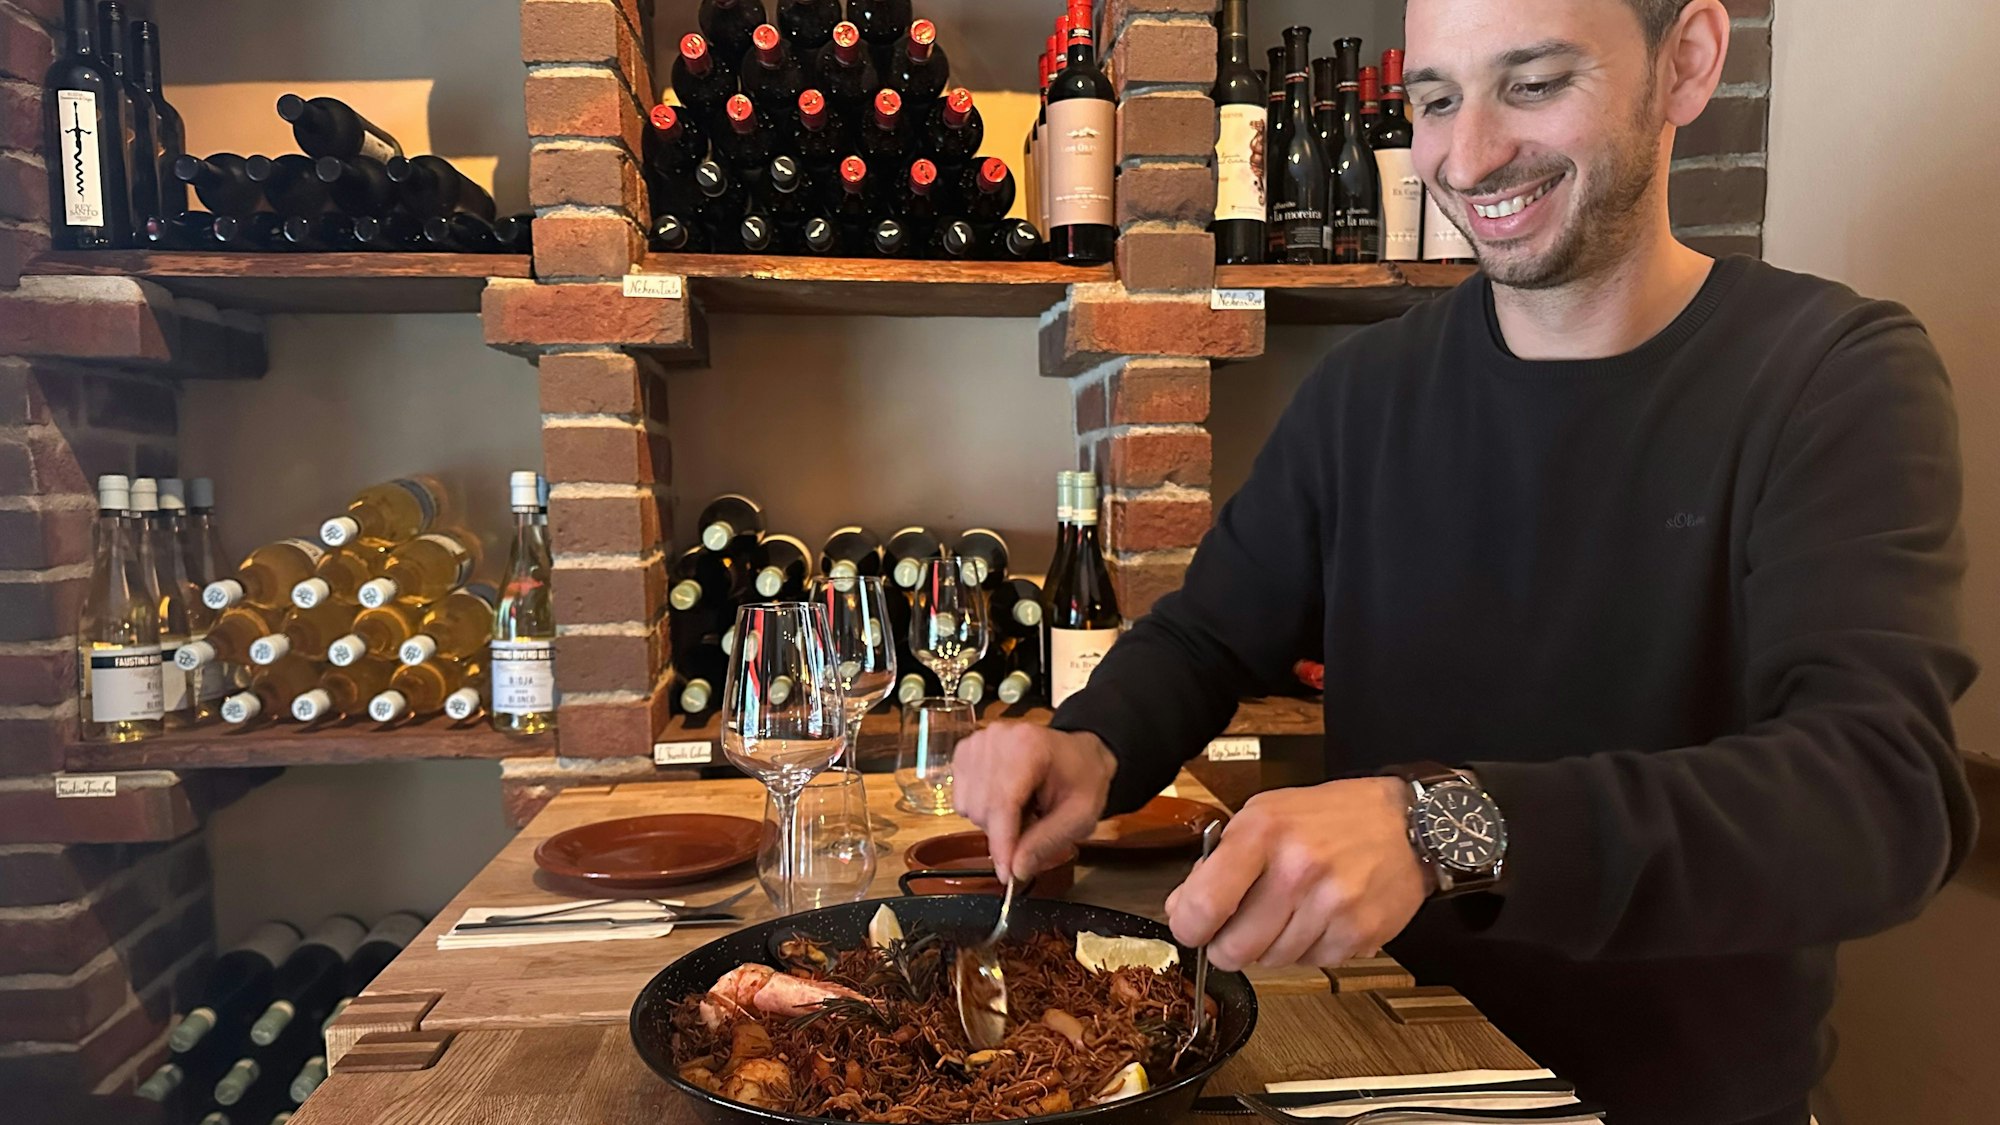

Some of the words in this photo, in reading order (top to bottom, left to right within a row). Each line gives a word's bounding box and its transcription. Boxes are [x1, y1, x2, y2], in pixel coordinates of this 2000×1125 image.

[1285, 207, 1322, 220] moreira
[115, 656, 149, 667] FAUSTINO
[509, 676, 533, 686] RIOJA
